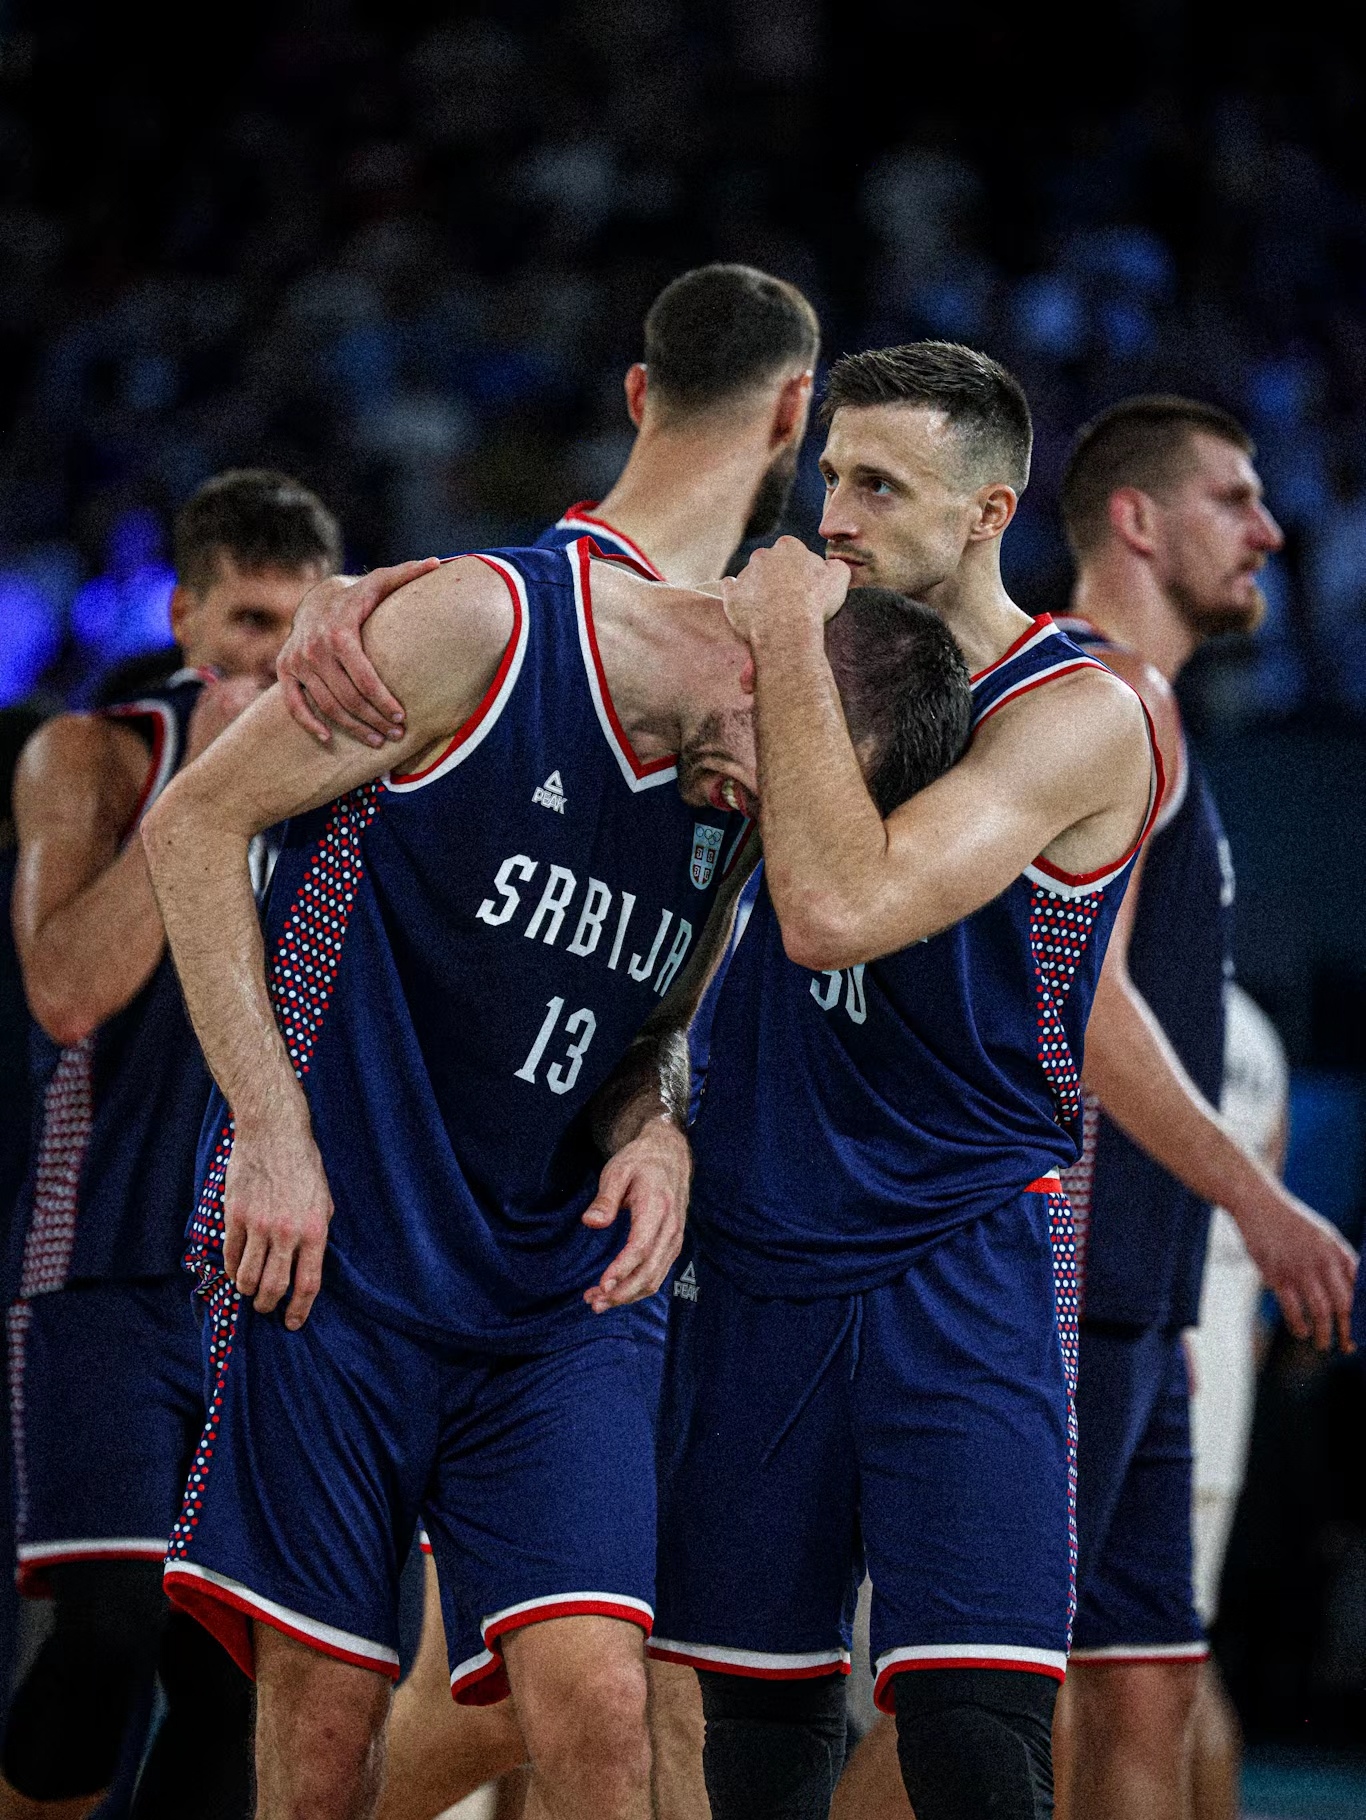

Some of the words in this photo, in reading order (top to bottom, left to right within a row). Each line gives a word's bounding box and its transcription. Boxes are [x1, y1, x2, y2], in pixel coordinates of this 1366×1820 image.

[531, 786, 568, 815] PEAK
[475, 853, 693, 998] SRBIJA
[513, 995, 597, 1095] 13
[673, 1280, 700, 1303] PEAK
